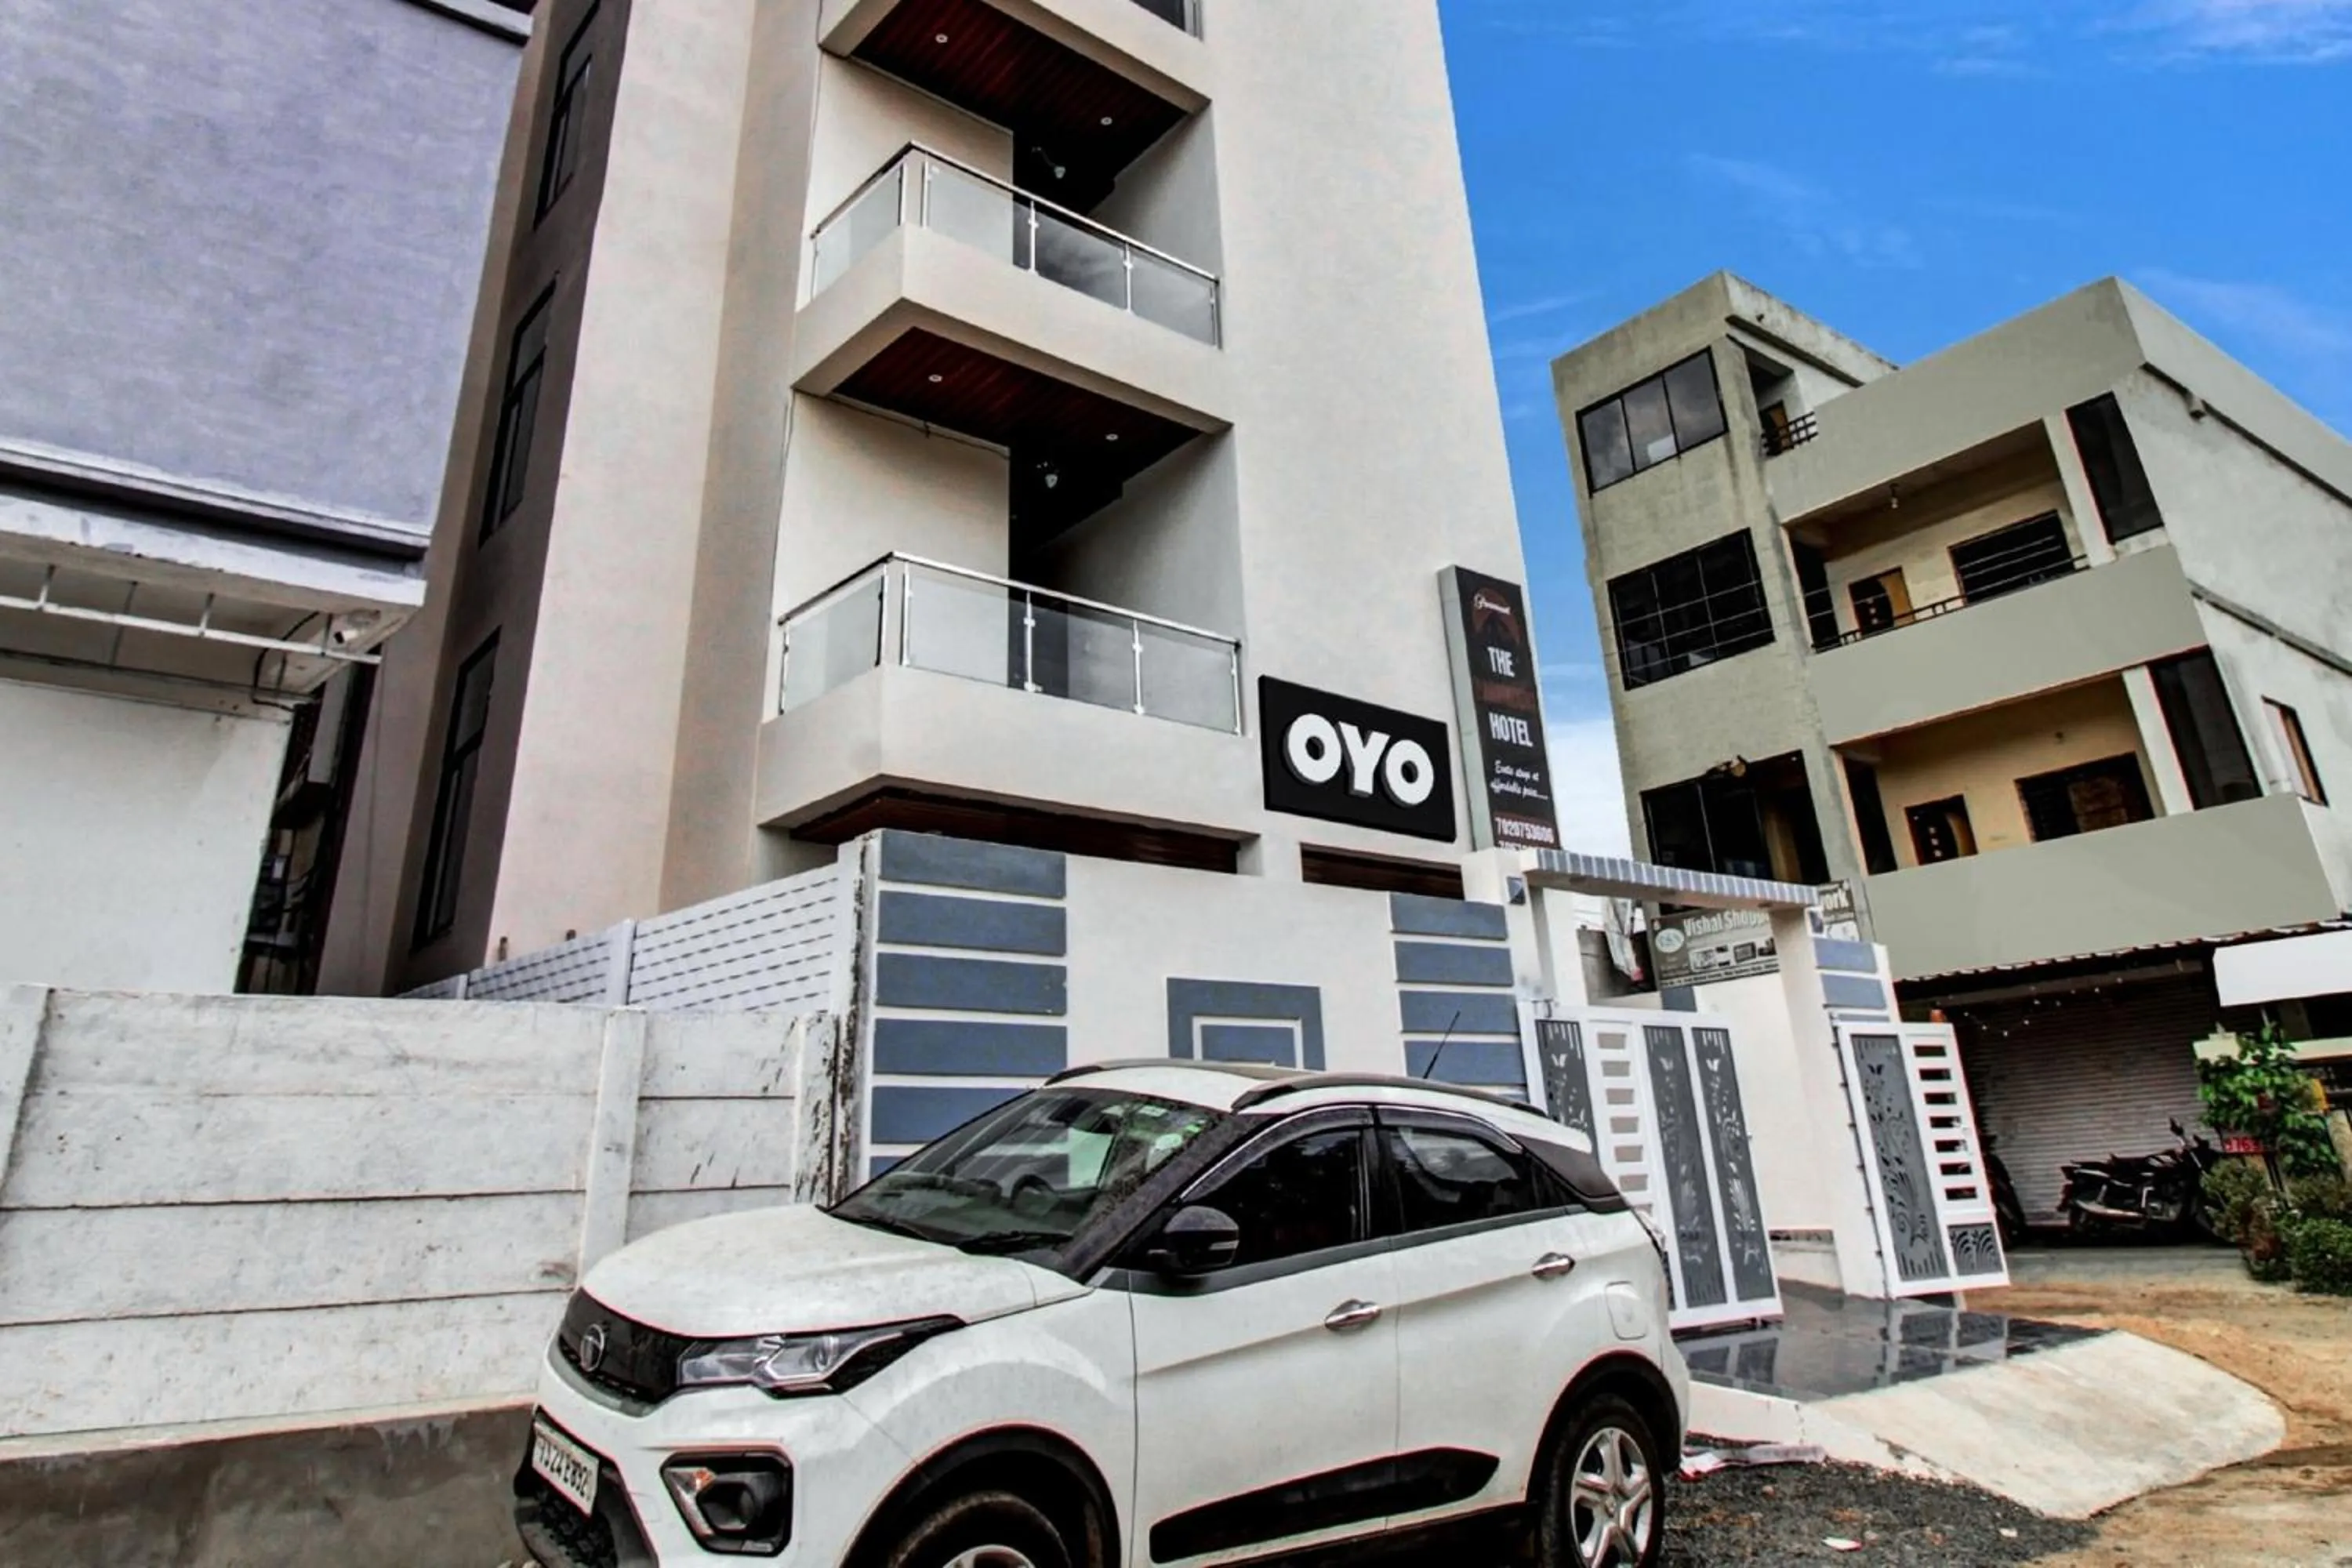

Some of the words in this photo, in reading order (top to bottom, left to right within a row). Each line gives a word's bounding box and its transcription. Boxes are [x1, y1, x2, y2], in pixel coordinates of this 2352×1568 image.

[1486, 647, 1515, 677] THE
[1488, 712, 1533, 747] HOTEL
[1286, 713, 1434, 806] OYO
